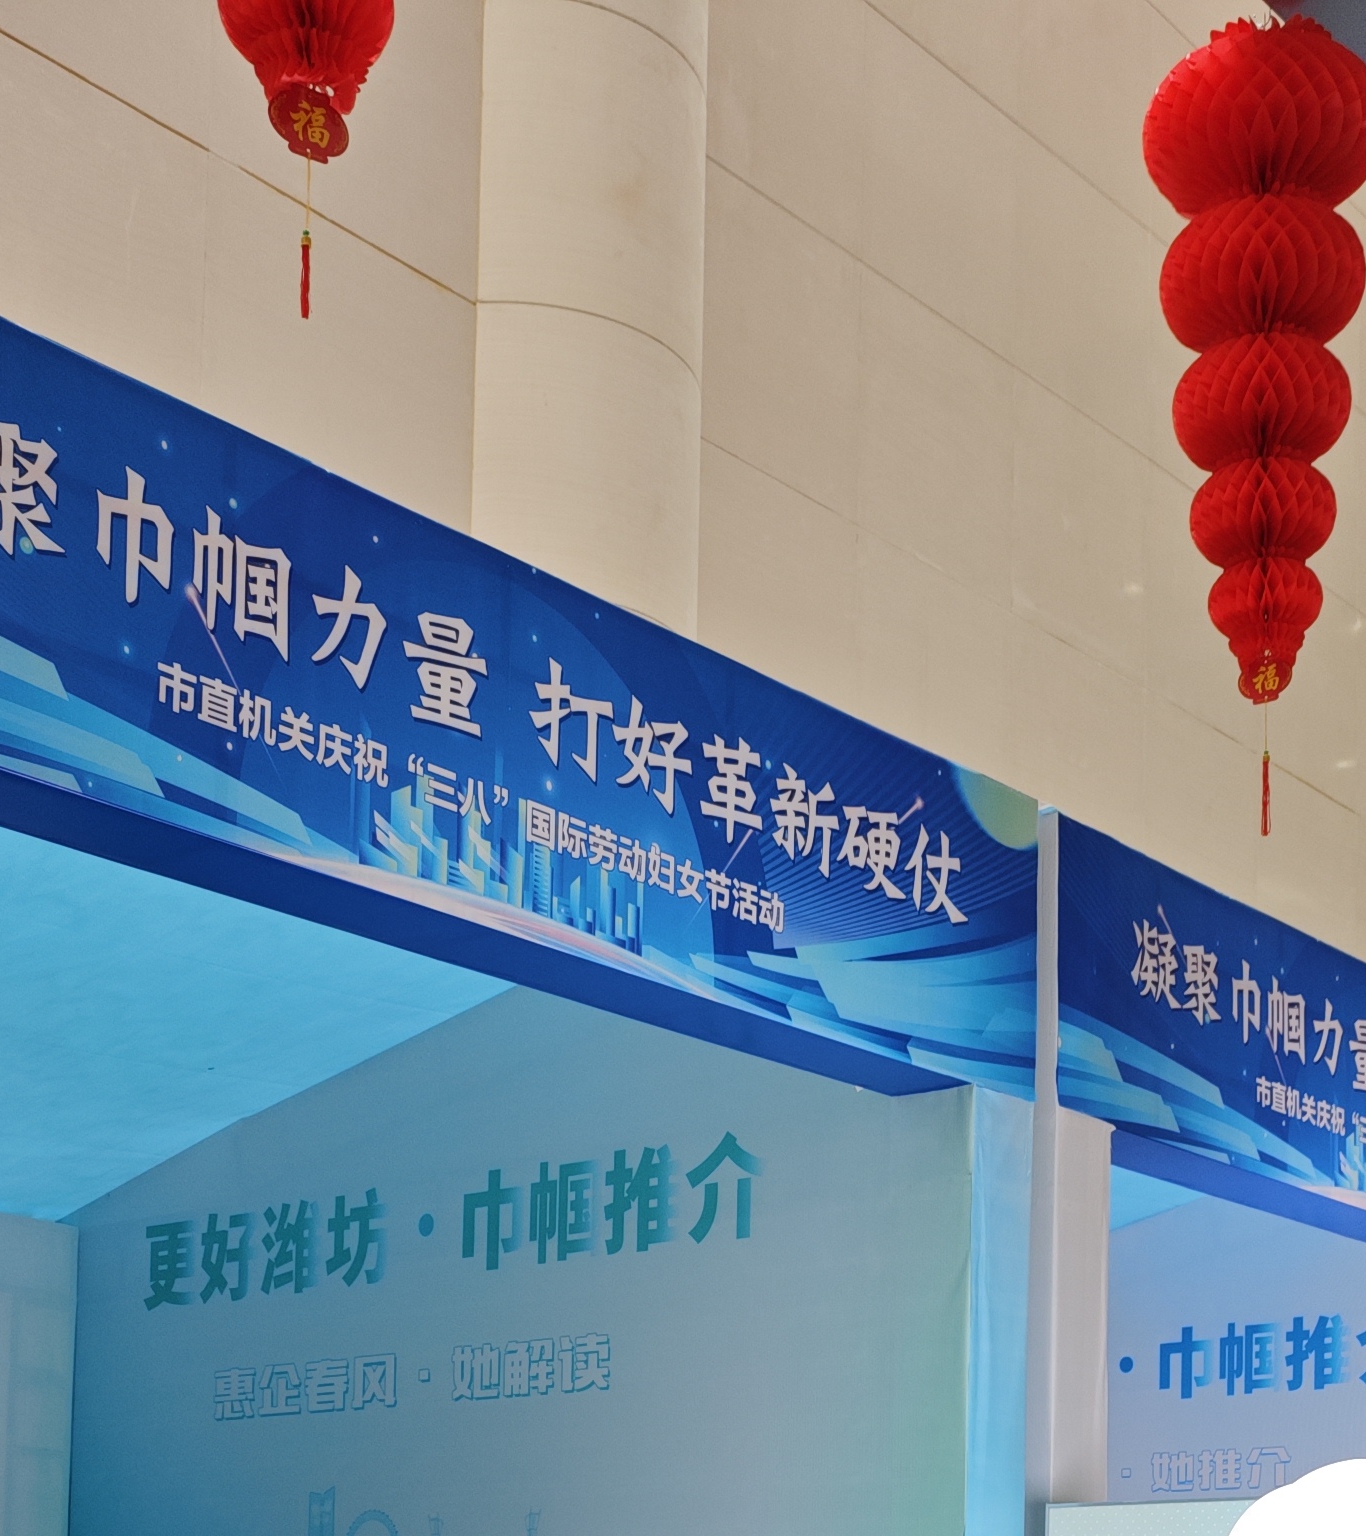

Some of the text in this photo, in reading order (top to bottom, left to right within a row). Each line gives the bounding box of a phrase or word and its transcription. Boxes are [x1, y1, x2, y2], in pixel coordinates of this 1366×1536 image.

[289, 100, 332, 149] 福
[95, 465, 489, 740] 巾帼力量
[528, 657, 970, 924] 打好革新硬仗
[1252, 662, 1281, 694] 福
[1130, 918, 1222, 1026] 凝聚
